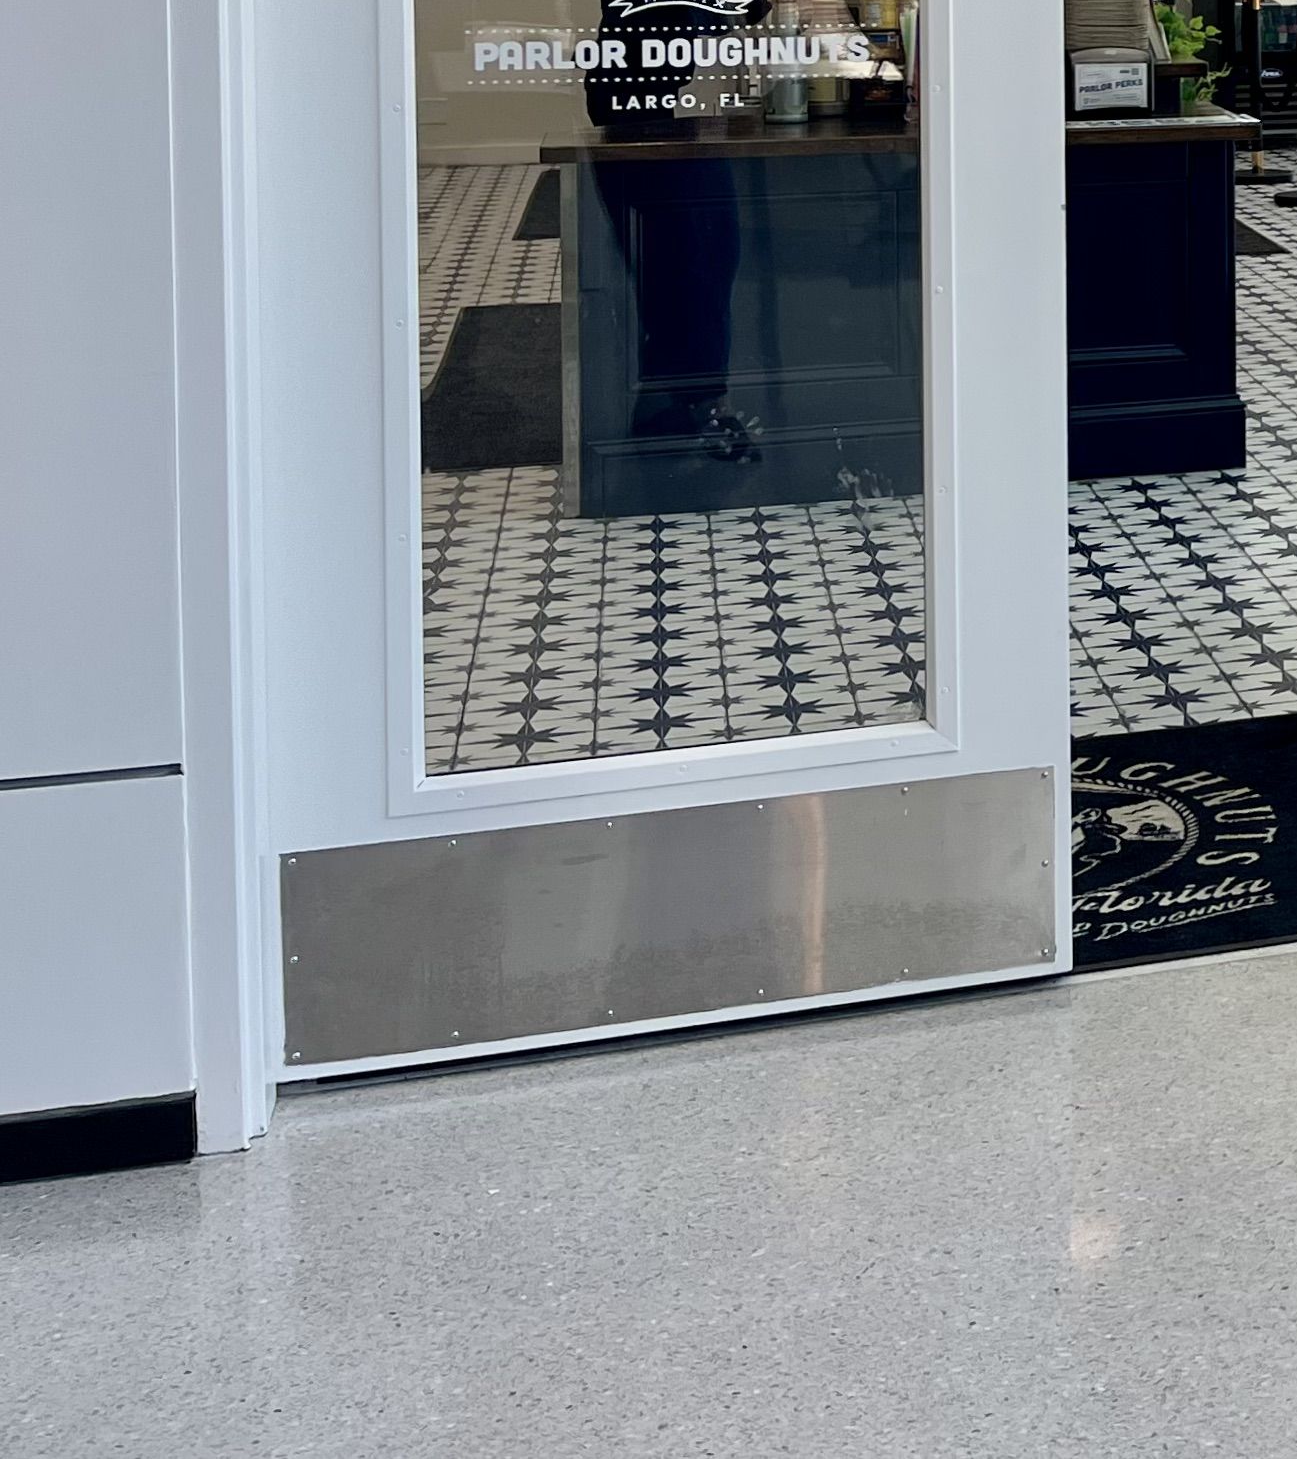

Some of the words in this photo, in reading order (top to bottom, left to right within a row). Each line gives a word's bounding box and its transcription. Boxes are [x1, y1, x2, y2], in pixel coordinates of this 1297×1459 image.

[474, 39, 628, 72] PARLOR
[641, 37, 870, 69] DOUGHNUTS
[1079, 82, 1112, 94] PARLOR
[1115, 78, 1144, 90] PERKS
[611, 94, 706, 110] LARGO,
[719, 93, 745, 108] FL
[1094, 892, 1277, 941] DOUGHNUTS
